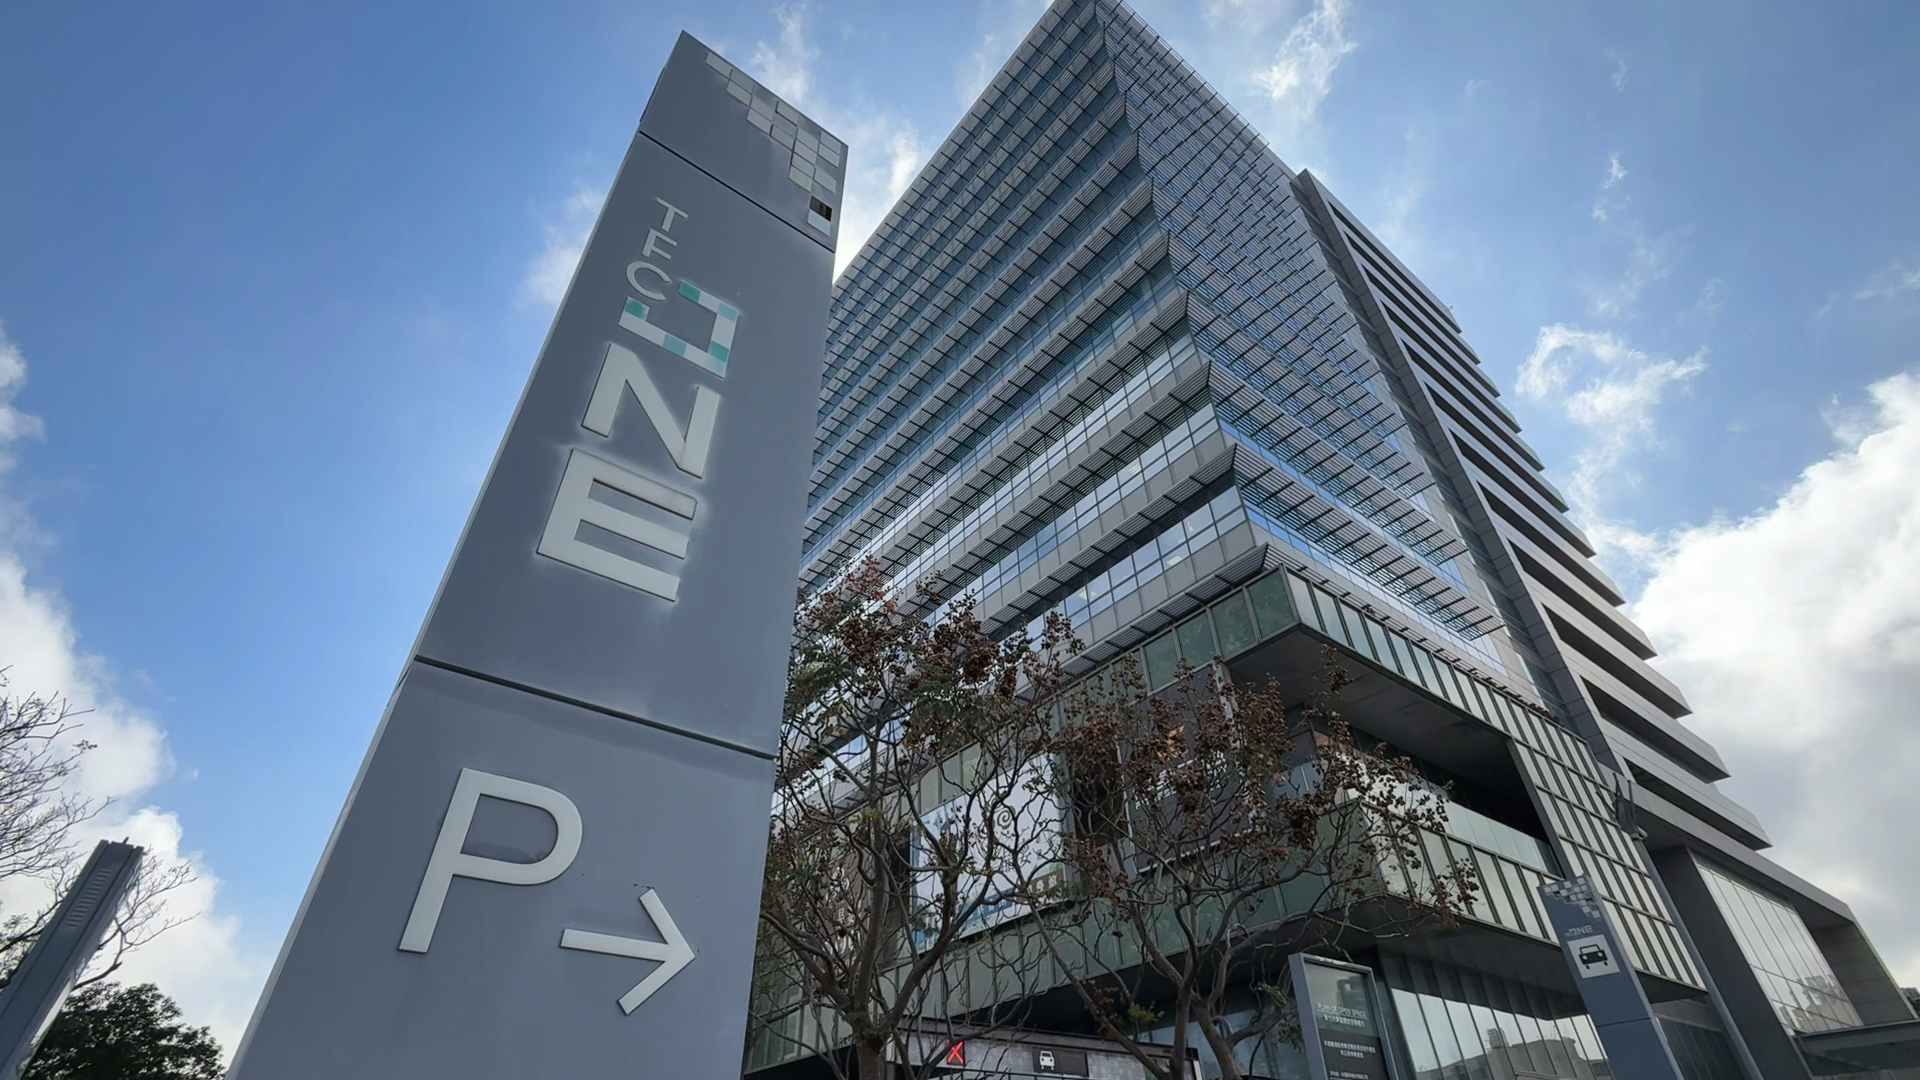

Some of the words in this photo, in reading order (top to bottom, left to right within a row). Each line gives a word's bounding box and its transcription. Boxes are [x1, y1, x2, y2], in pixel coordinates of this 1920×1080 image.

[625, 197, 688, 301] TFC
[535, 279, 741, 602] ONE
[398, 767, 583, 953] P
